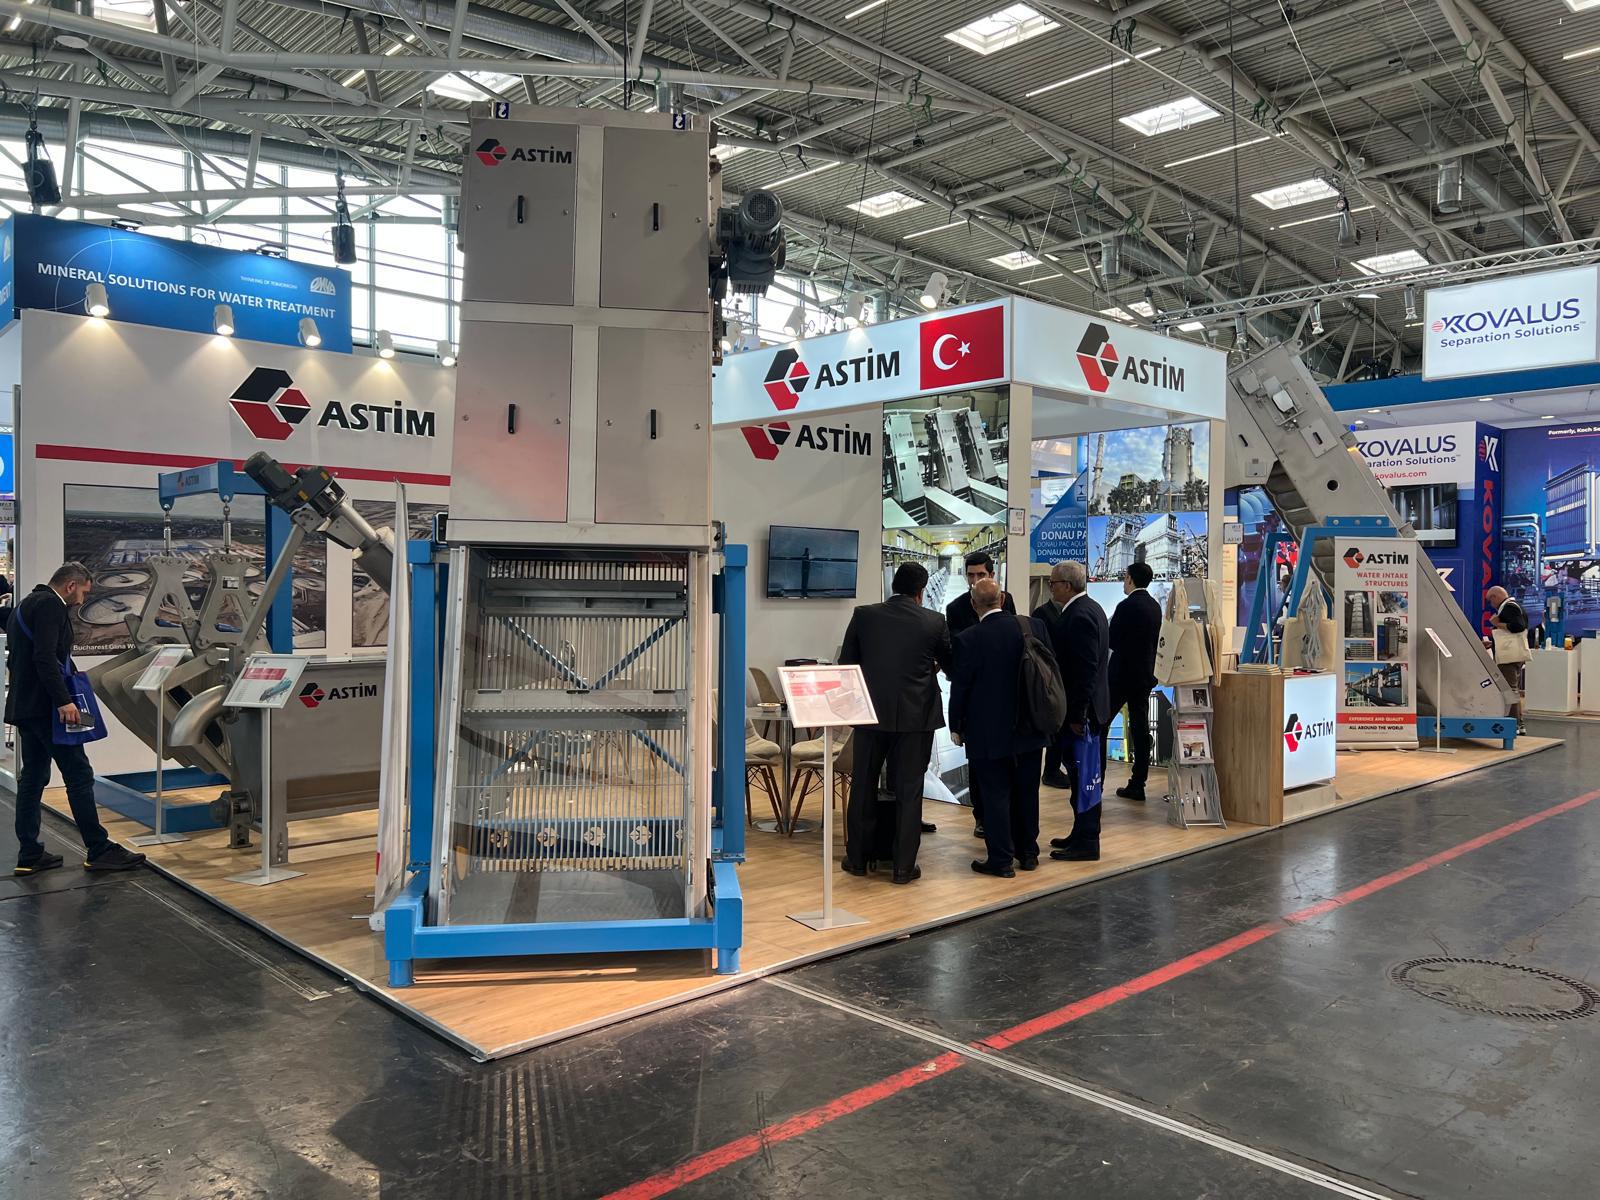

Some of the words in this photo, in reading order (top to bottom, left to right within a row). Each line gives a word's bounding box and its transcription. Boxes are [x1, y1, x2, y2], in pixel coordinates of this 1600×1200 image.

[37, 262, 105, 283] MINERAL
[108, 273, 187, 295] SOLUTIONS
[190, 286, 216, 301] FOR
[218, 291, 263, 308] WATER
[265, 298, 337, 319] TREATMENT
[1441, 298, 1580, 334] KOVALUS
[1440, 332, 1510, 348] Separation
[1366, 459, 1402, 468] aration
[1041, 531, 1075, 540] DONAU
[1076, 530, 1087, 540] PA
[1062, 548, 1087, 556] EVOLUT
[1482, 479, 1494, 637] KOVALU
[73, 643, 108, 651] Bucharest
